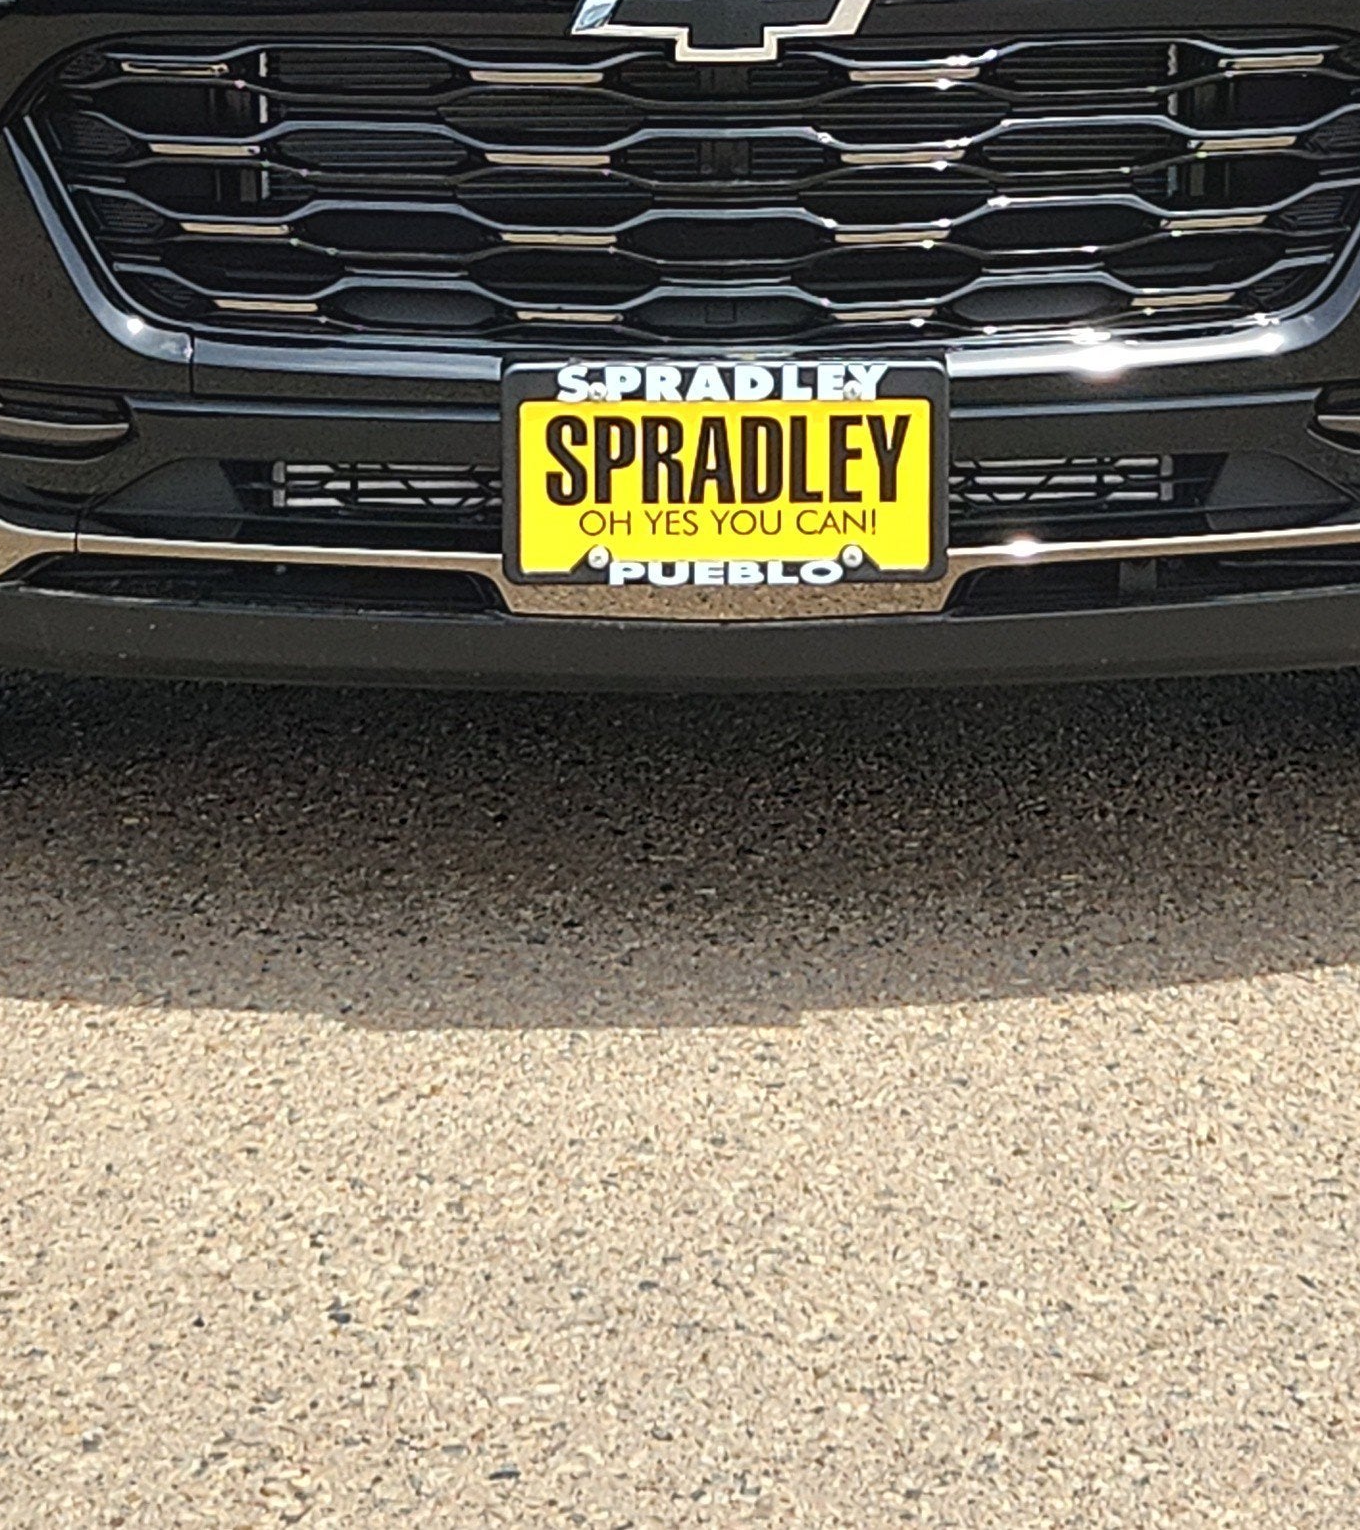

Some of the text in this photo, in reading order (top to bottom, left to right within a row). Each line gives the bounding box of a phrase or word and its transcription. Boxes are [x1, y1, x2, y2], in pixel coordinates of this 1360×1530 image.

[556, 364, 888, 402] SPRADLEY
[545, 413, 913, 506] SPRADLEY
[578, 508, 878, 537] OH YES YOU CAN!
[608, 559, 845, 587] PUEBLO
